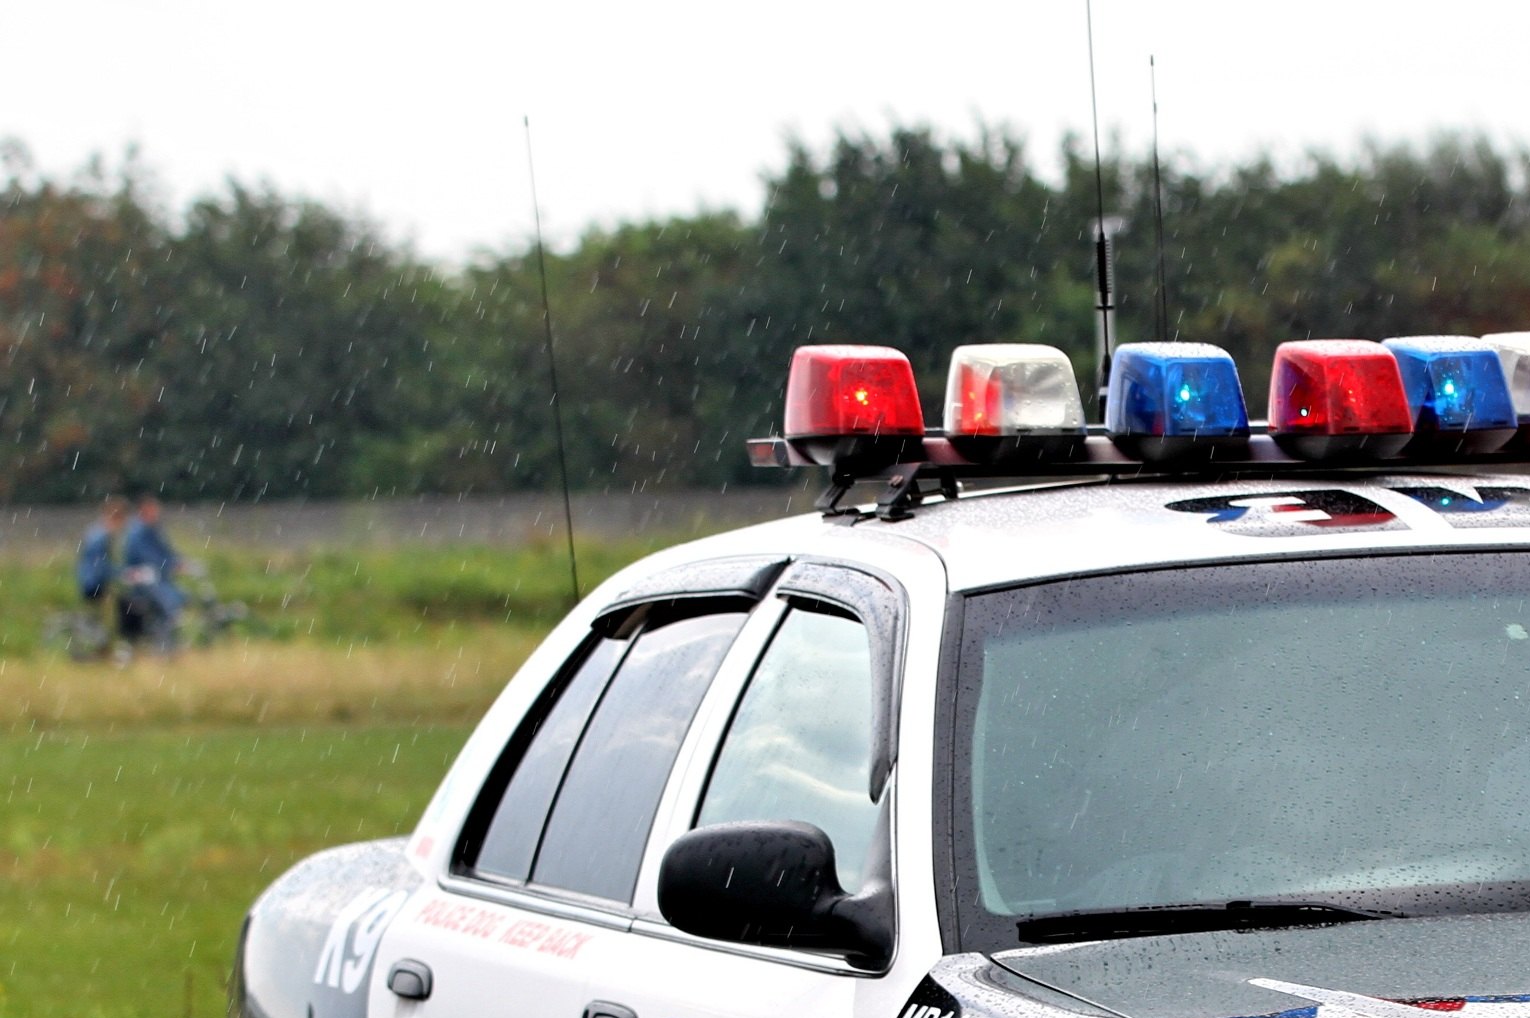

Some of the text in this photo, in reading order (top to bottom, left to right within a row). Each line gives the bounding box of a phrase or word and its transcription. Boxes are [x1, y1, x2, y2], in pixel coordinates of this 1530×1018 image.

[314, 885, 409, 995] K9
[414, 898, 476, 931] POLICE
[497, 919, 552, 949] KEEP
[536, 926, 595, 960] BACK
